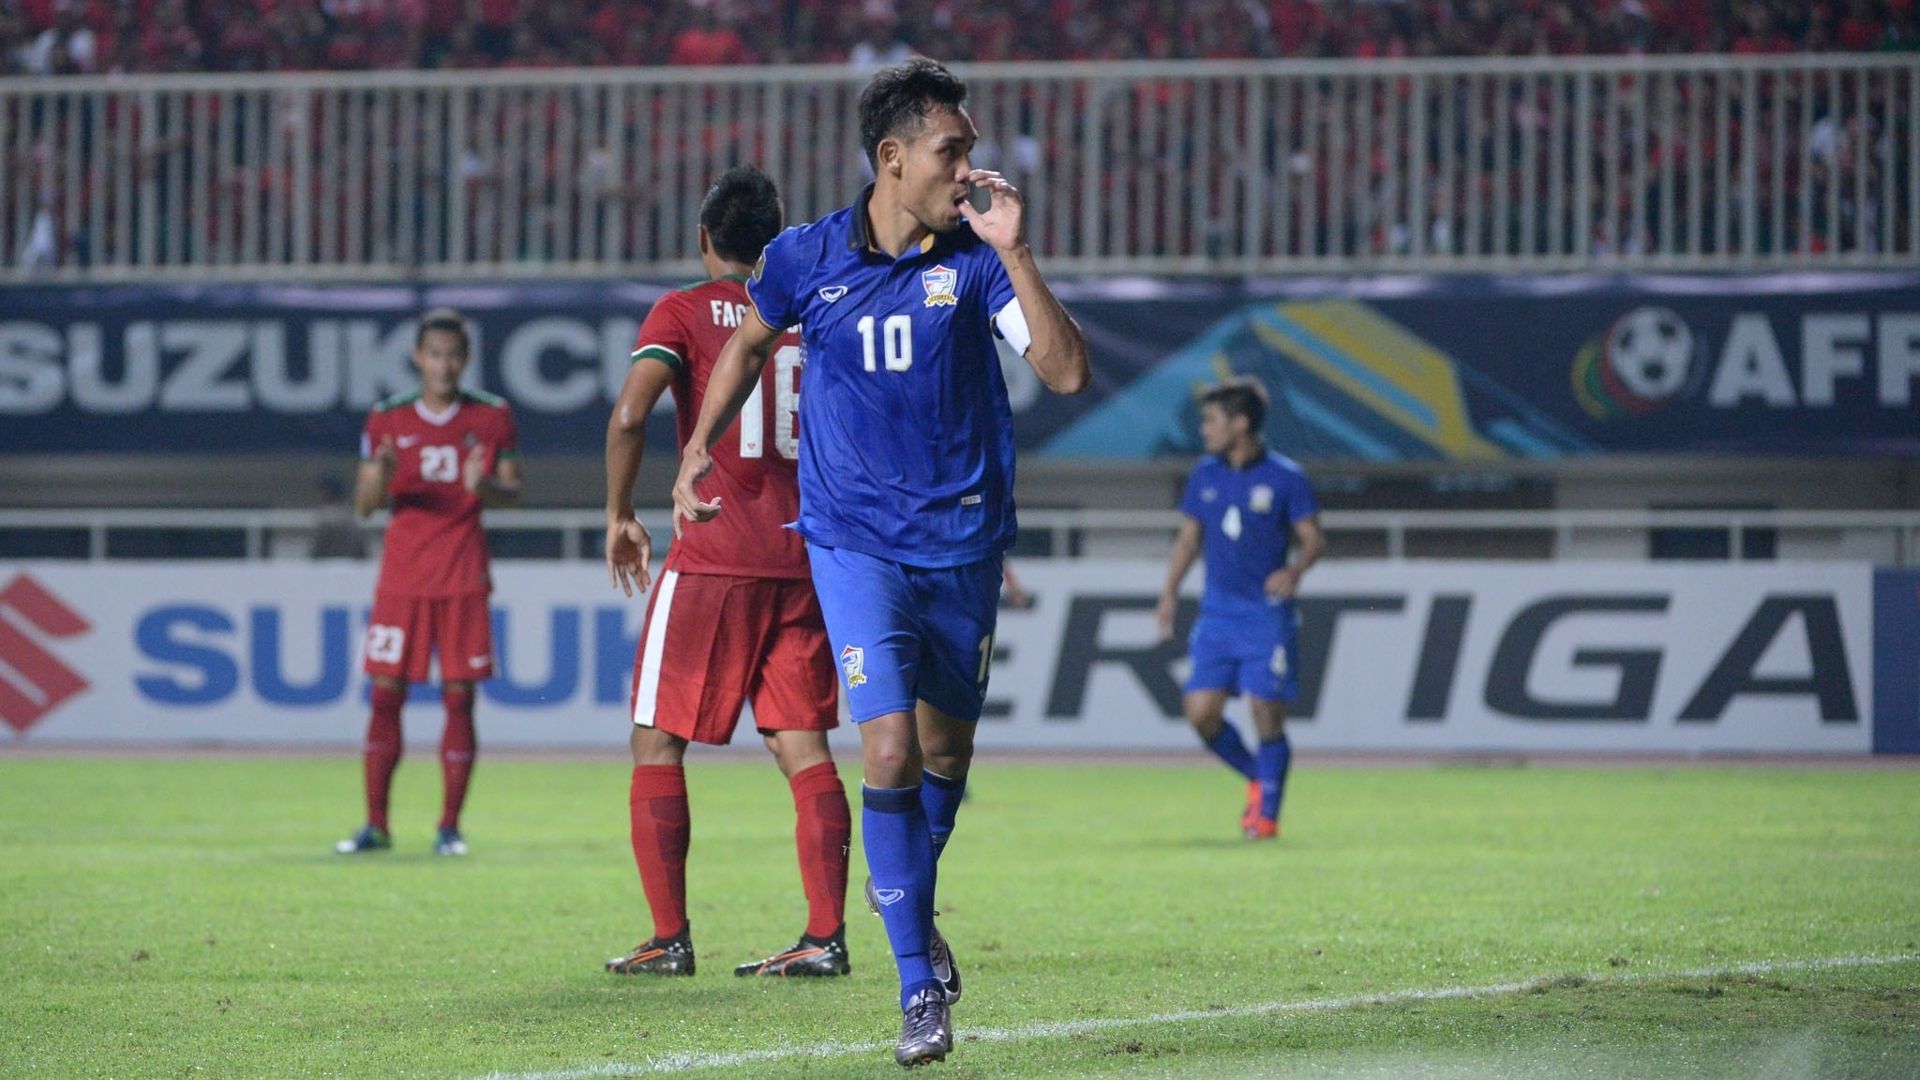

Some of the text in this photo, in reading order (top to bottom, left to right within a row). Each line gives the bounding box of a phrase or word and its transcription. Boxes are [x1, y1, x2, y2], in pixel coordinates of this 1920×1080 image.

[857, 314, 912, 372] 10
[420, 446, 459, 482] 23
[1221, 505, 1243, 541] 4
[133, 604, 641, 708] SUU
[367, 623, 405, 664] 23
